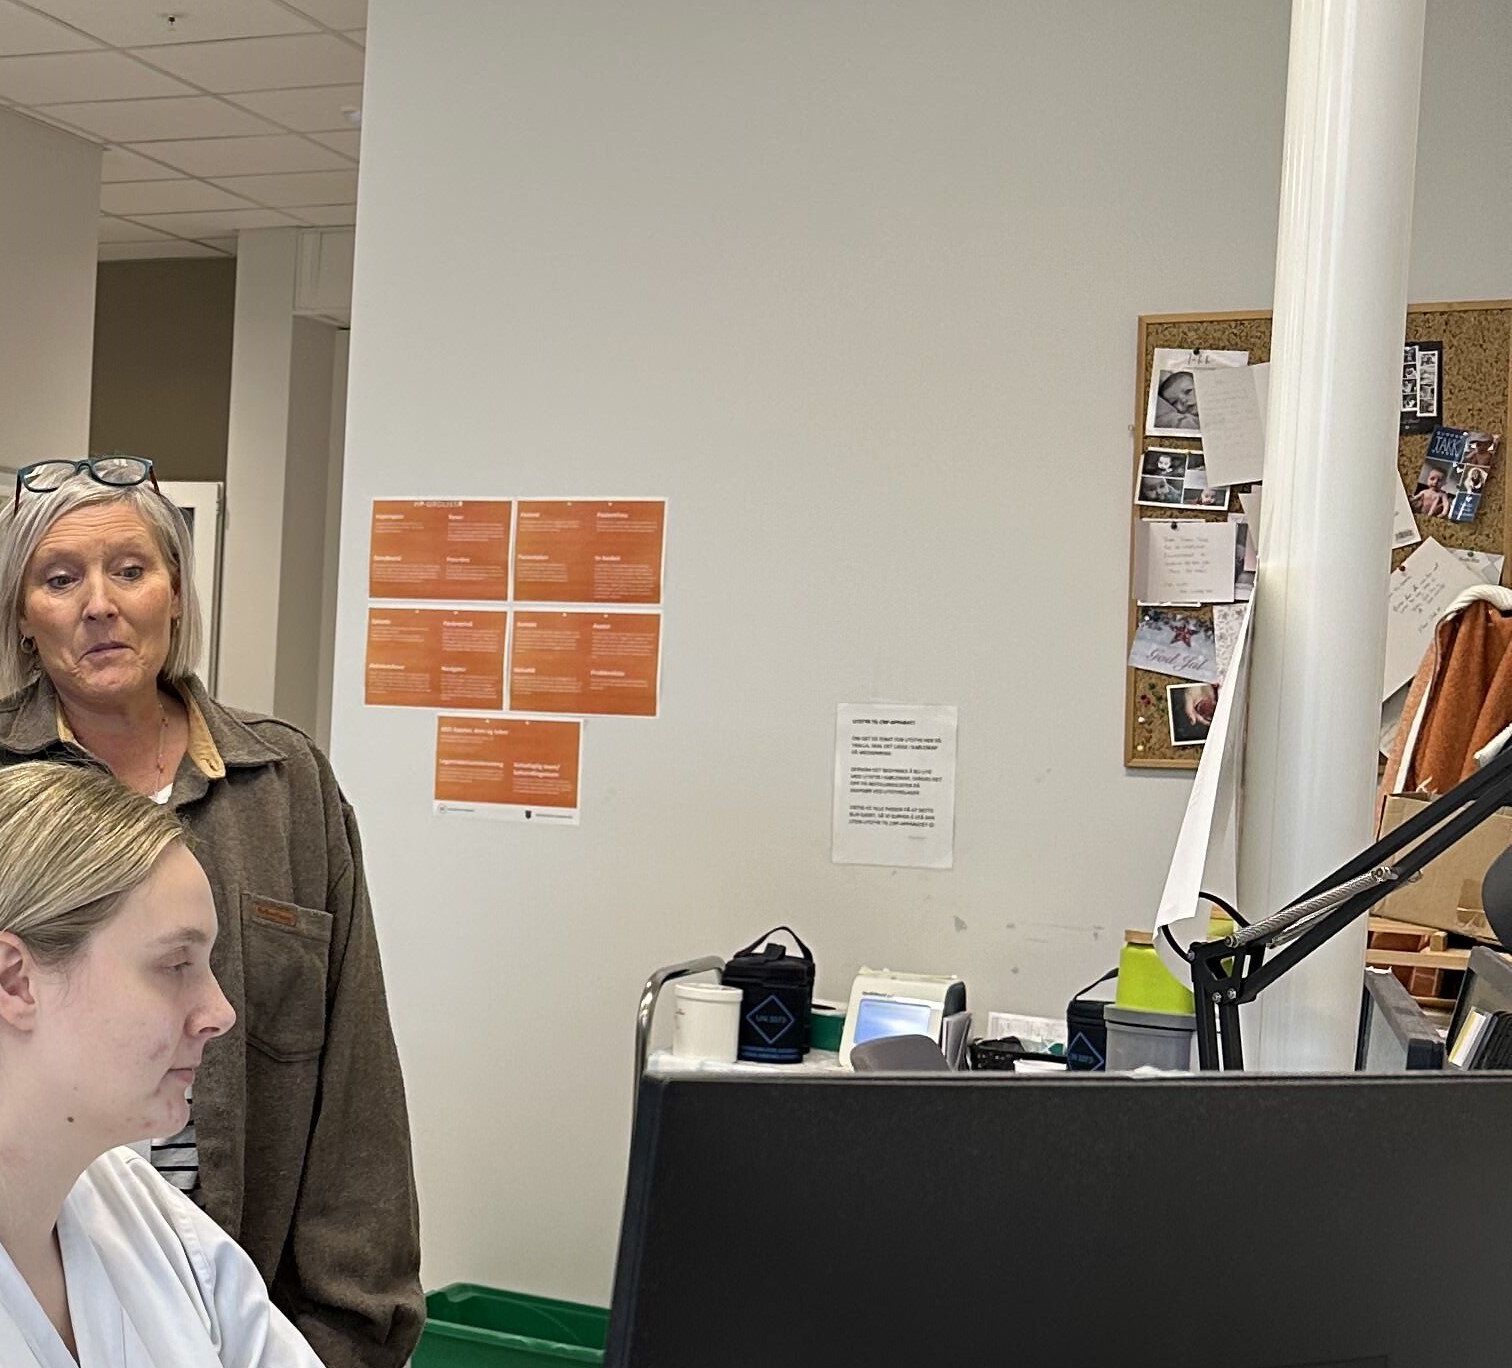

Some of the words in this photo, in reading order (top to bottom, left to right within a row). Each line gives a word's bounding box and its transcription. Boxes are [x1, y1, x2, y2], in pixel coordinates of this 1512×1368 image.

[1433, 435, 1460, 457] TAKK
[1146, 650, 1178, 668] God
[1174, 655, 1209, 671] Jul
